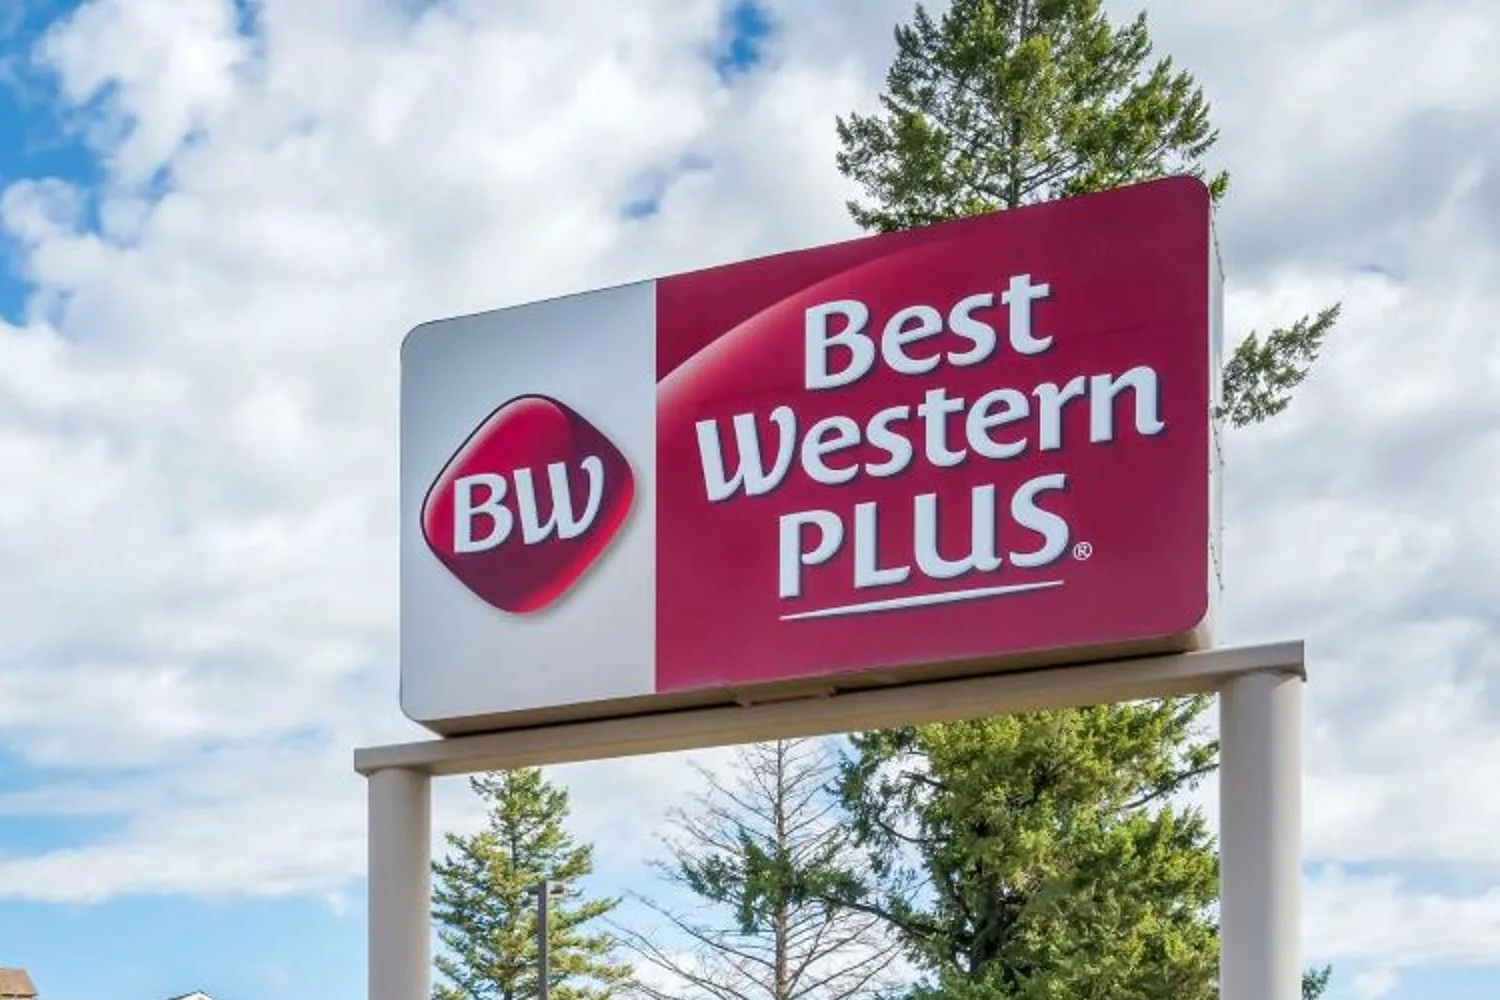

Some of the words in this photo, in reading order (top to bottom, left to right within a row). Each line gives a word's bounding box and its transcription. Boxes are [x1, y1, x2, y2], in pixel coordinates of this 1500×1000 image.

[803, 272, 1054, 391] Best
[694, 364, 1166, 503] Western
[452, 454, 605, 555] BW
[777, 471, 1070, 600] PLUS
